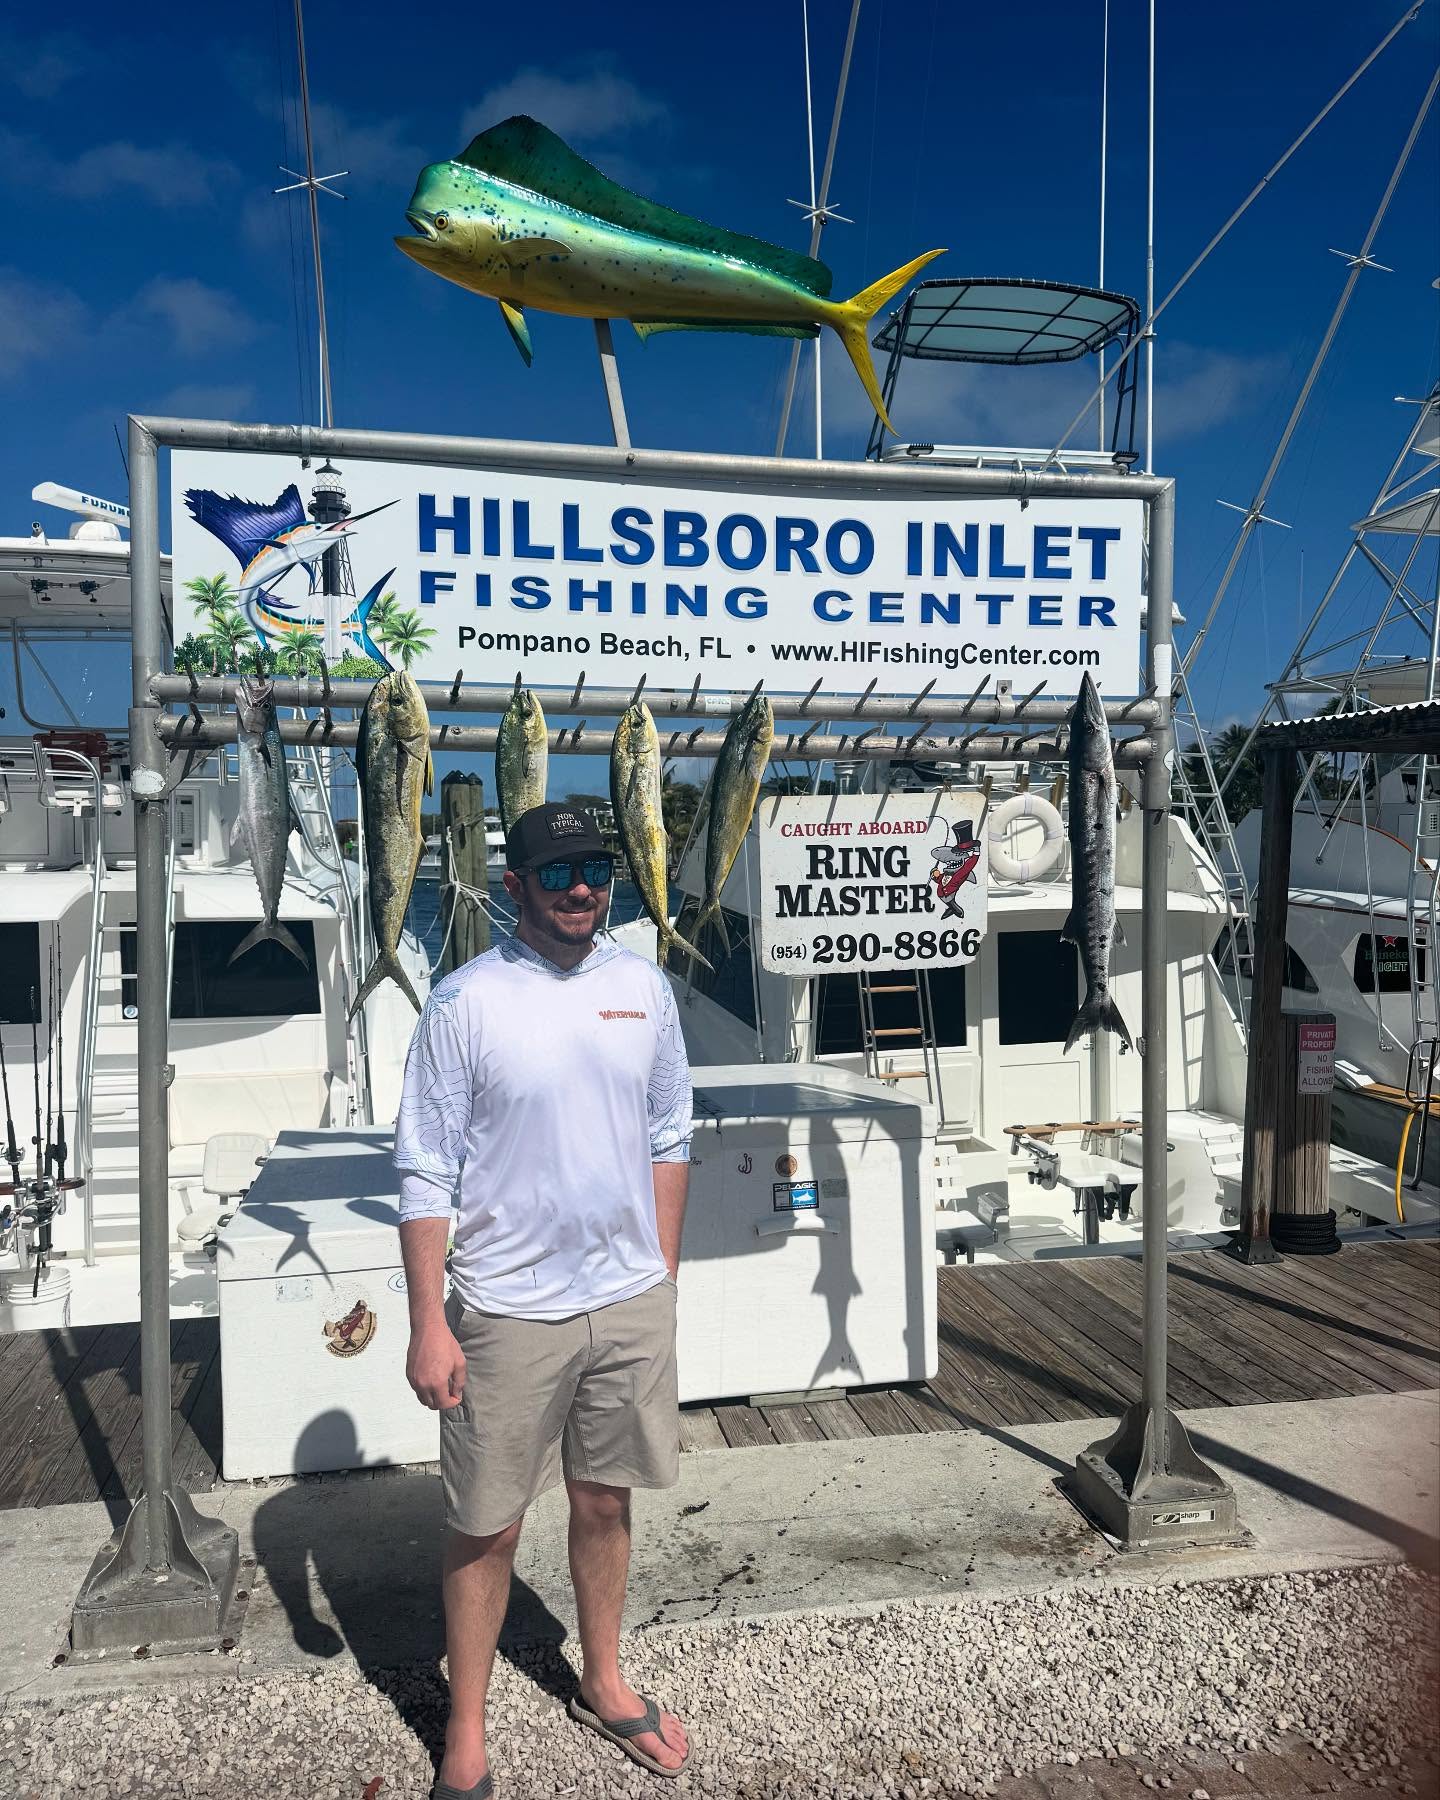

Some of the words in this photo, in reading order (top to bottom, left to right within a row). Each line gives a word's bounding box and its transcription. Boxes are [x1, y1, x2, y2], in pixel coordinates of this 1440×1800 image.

[418, 493, 875, 577] HILLSBORO
[907, 520, 1121, 581] INLET
[420, 570, 768, 619] FISHING
[813, 590, 1118, 628] CENTER
[458, 625, 591, 657] Pompano
[600, 632, 690, 661] Beach,
[700, 637, 732, 659] FL
[771, 641, 1100, 670] www.HIFishingCenter.com
[551, 820, 584, 830] TYPICAL
[556, 813, 575, 821] NON
[780, 822, 853, 838] CAUGHT
[857, 820, 928, 836] ABOARD
[805, 844, 911, 880] RING
[775, 884, 936, 918] MASTER
[771, 943, 807, 961] (954)
[812, 928, 981, 964] 290-8866
[1317, 1054, 1328, 1063] NO
[774, 1182, 817, 1192] PELAGIC
